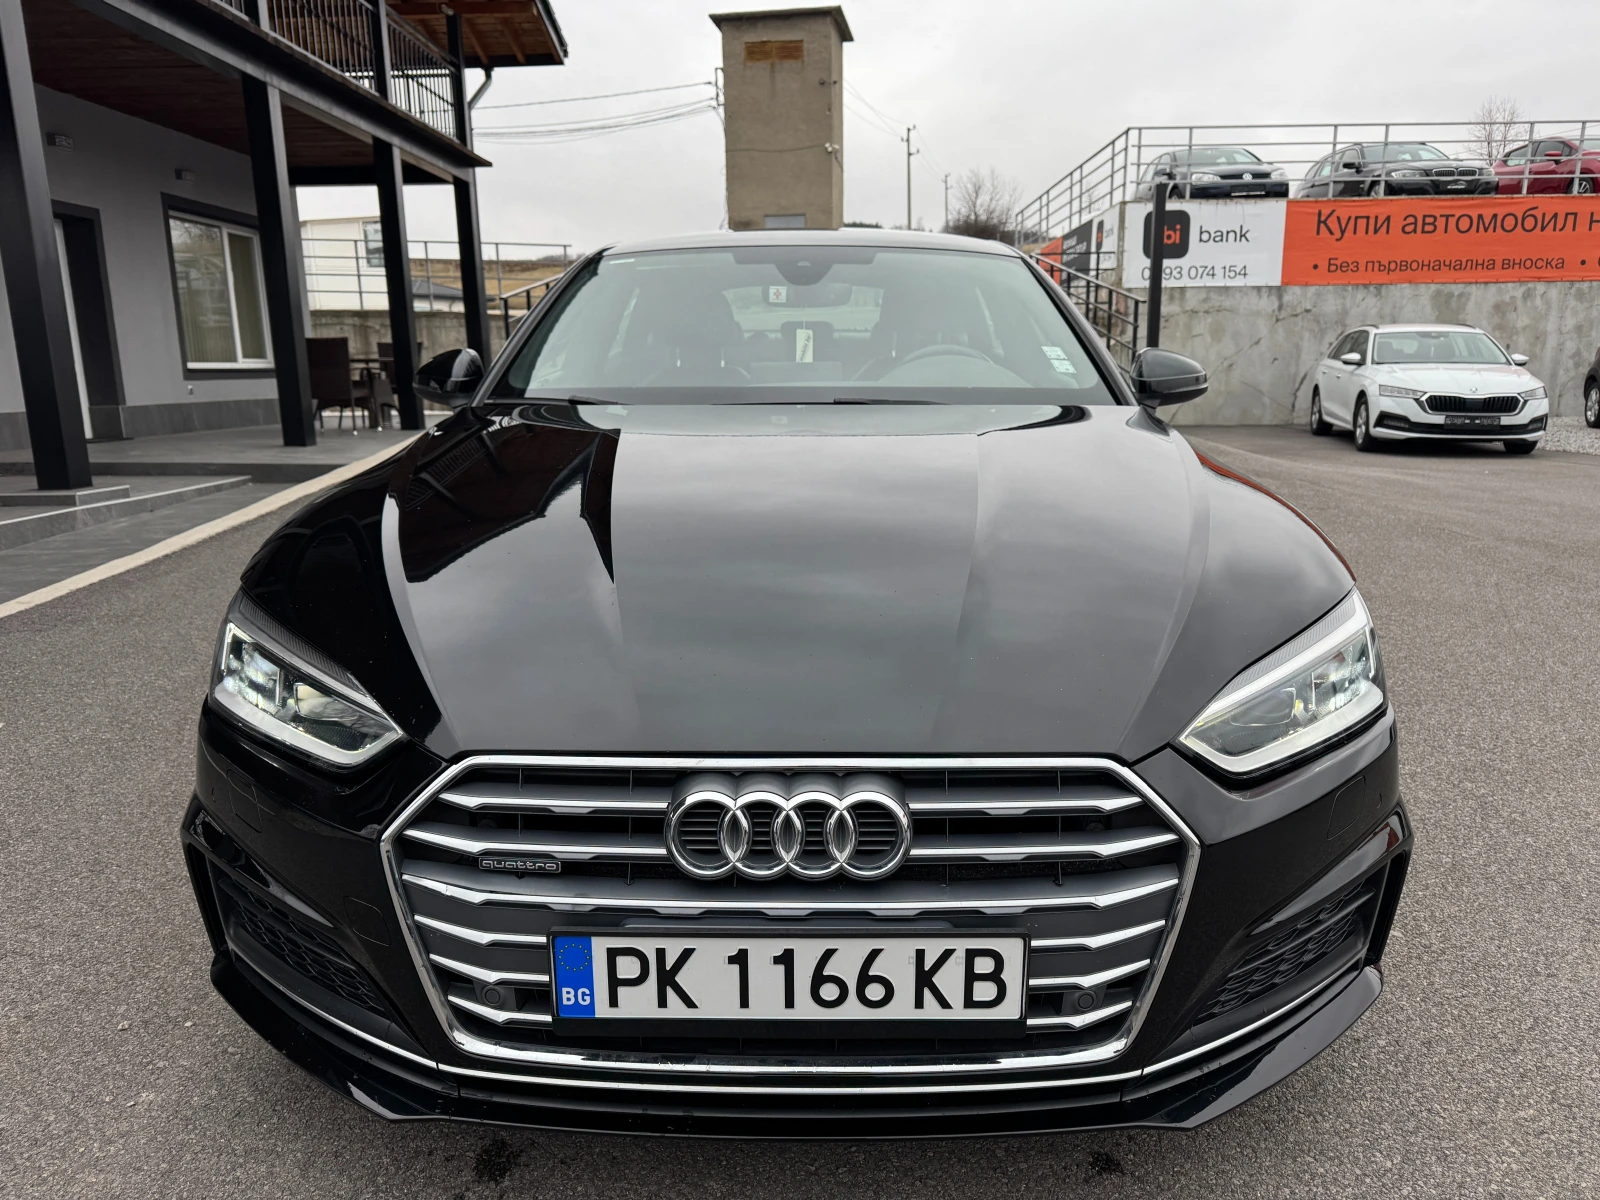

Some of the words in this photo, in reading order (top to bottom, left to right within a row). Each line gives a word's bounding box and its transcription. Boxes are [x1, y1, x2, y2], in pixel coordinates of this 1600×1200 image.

[1315, 209, 1391, 242] Купи
[1401, 206, 1578, 235] автомобил
[1163, 224, 1181, 244] bi
[1199, 225, 1250, 243] bank
[1141, 265, 1183, 281] 093
[1187, 265, 1217, 280] 074
[1222, 265, 1249, 280] 154
[1327, 257, 1360, 273] Без
[1364, 257, 1497, 275] първоначална
[1501, 257, 1565, 270] вноска
[482, 860, 557, 870] quattro
[606, 946, 699, 1009] PK
[727, 948, 895, 1009] 1166
[914, 948, 1007, 1010] KB
[561, 987, 591, 1006] BG
